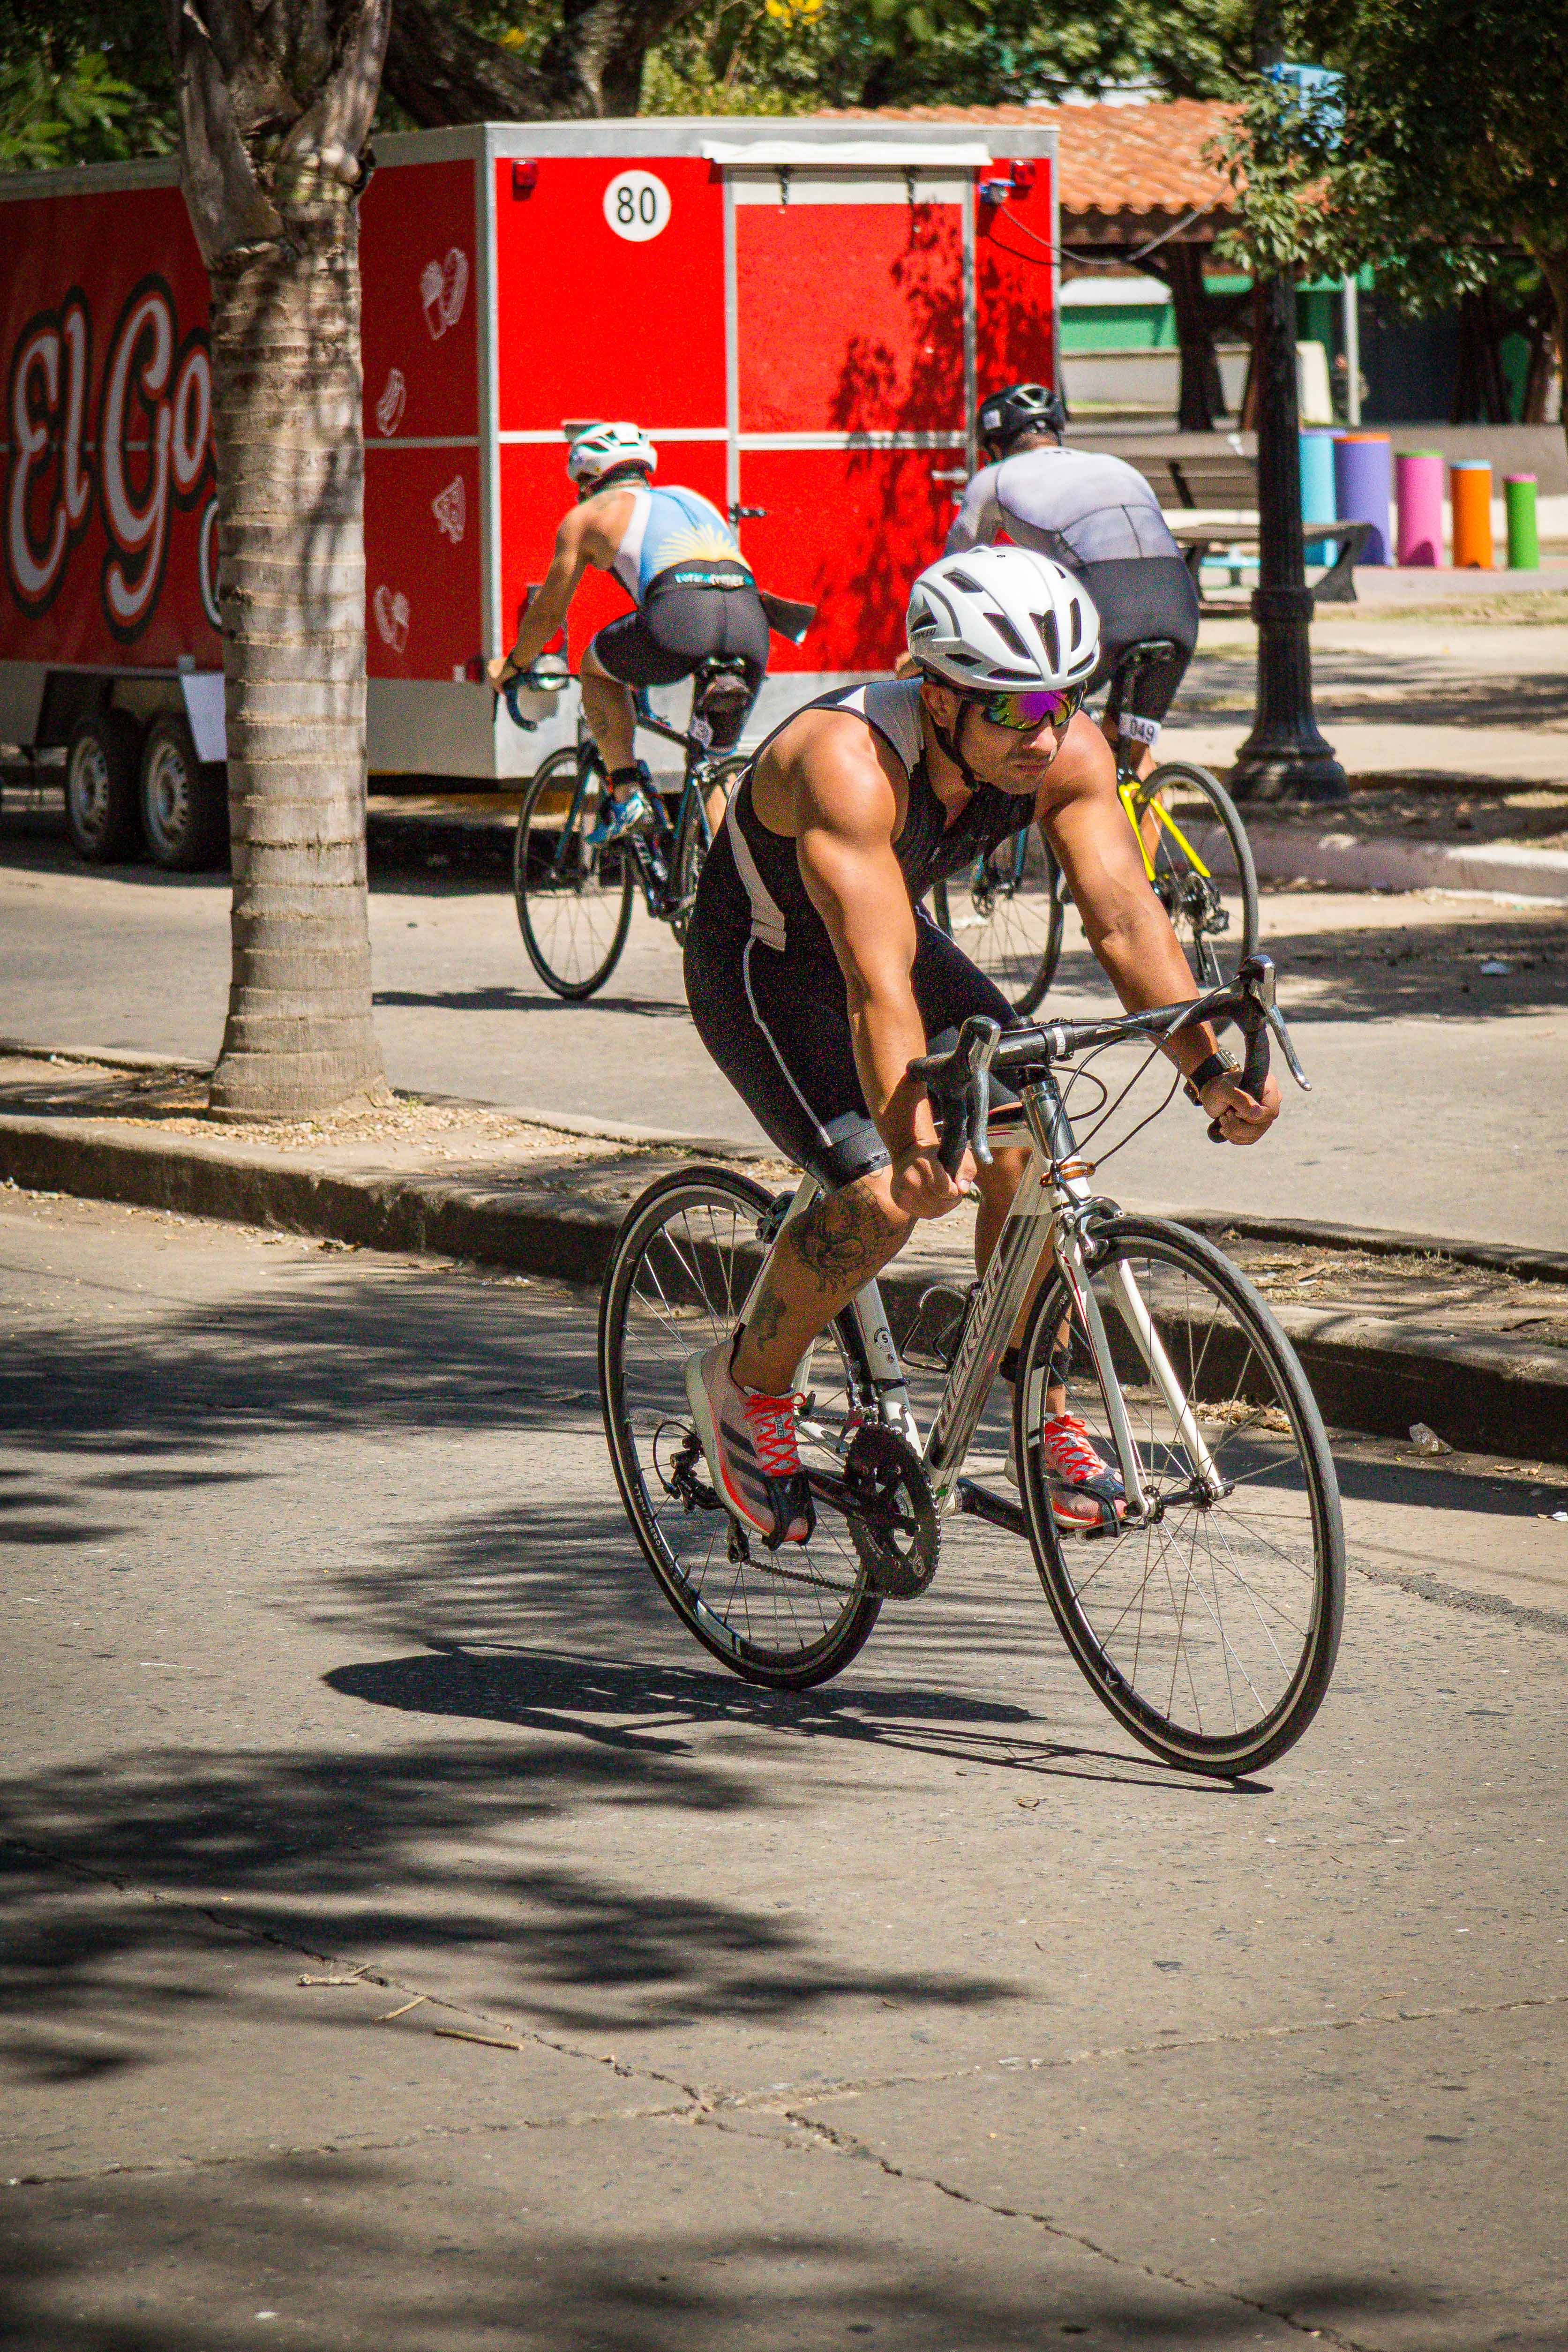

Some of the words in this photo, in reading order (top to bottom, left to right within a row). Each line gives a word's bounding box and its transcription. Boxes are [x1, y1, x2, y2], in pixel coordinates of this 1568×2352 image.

[618, 187, 656, 224] 80
[7, 300, 91, 605] El
[101, 286, 212, 628] Go
